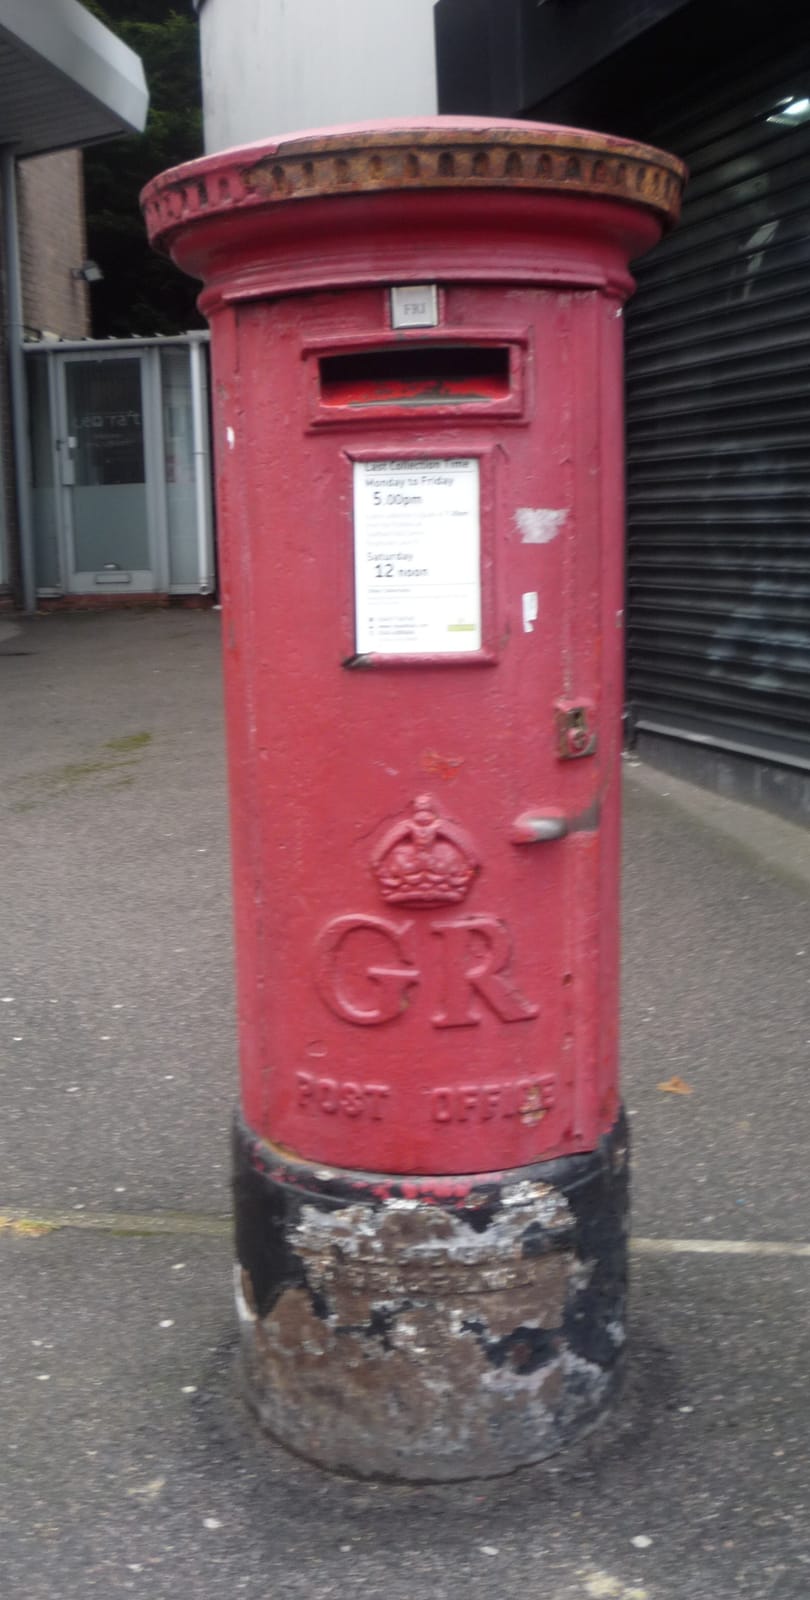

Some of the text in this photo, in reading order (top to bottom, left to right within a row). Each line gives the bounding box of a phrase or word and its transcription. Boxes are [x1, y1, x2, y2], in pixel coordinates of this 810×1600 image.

[402, 302, 427, 316] FRI
[365, 458, 470, 472] Last Collection Time
[365, 475, 454, 489] Monday to Friday
[373, 491, 422, 507] 5.00pm
[367, 551, 414, 562] Saturday
[375, 563, 429, 578] 12 noon
[296, 1070, 556, 1124] POST OFFICE
